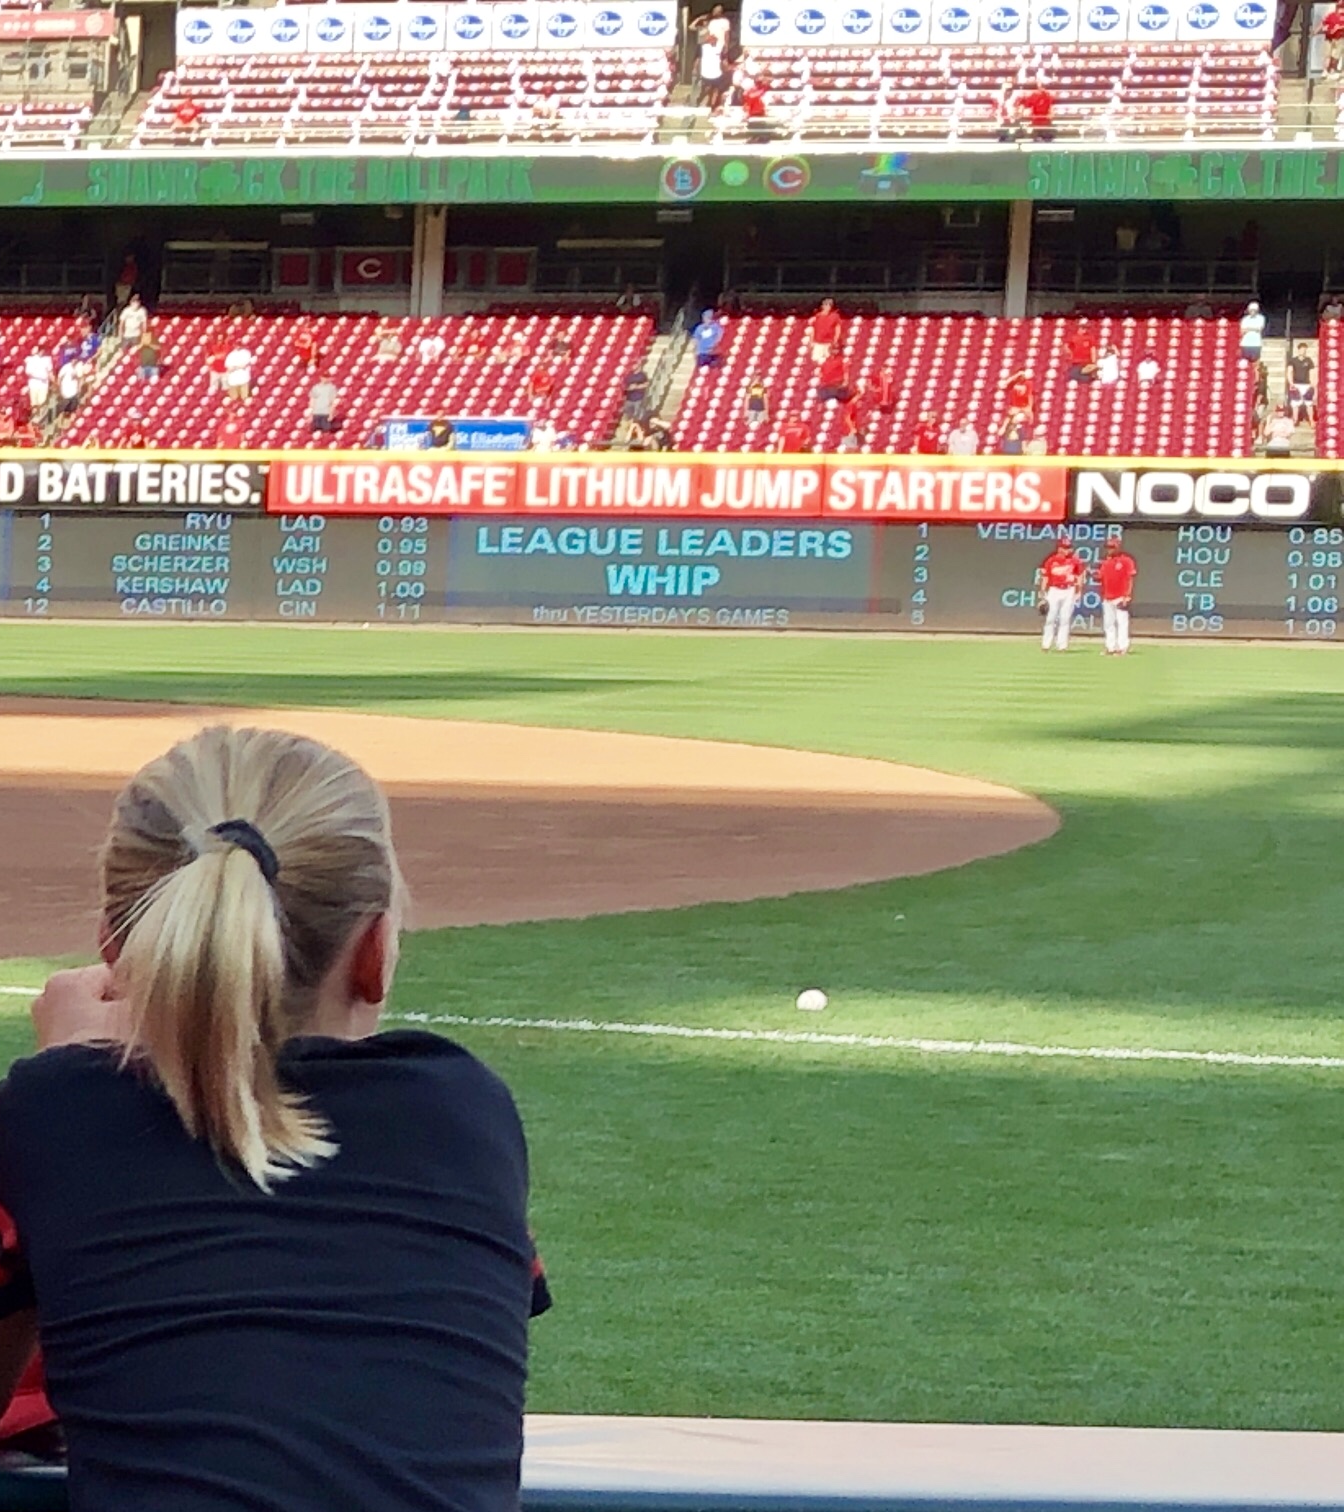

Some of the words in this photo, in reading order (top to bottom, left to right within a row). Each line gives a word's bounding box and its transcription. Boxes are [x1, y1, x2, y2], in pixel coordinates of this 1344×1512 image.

[297, 158, 357, 201] THE
[525, 466, 691, 509] LITHIUM
[699, 468, 819, 510] JUMP
[827, 469, 1052, 514] STARTERS.
[1074, 471, 1313, 517] NOCO
[40, 513, 51, 529] 1
[184, 512, 232, 530] RYU
[279, 514, 326, 532] LAD
[377, 516, 430, 533] 0.93
[917, 522, 928, 539] 1
[976, 522, 1124, 542] VERLANDER
[1176, 525, 1233, 543] HOU
[37, 534, 53, 551] 2
[134, 534, 232, 552] GREINKE
[281, 536, 321, 553] ARI
[476, 526, 644, 557] LEAGUE
[657, 528, 853, 560] LEADERS
[37, 556, 52, 573] 3
[111, 555, 230, 573] SCHERZER
[272, 557, 328, 575] WSH
[915, 544, 930, 561] 2
[1176, 548, 1231, 565] HOU
[1287, 551, 1344, 568] 0.98
[35, 577, 52, 593] 4
[115, 577, 231, 595] KERSHAW
[276, 579, 323, 596] LAD
[376, 581, 426, 599] 1.00
[605, 563, 721, 596] WHIP
[913, 566, 928, 584] 3
[1177, 570, 1225, 588] CLE
[1287, 573, 1338, 590] 1.01
[23, 598, 50, 616] 12
[119, 598, 228, 616] CASTILLO
[278, 600, 317, 618] CIN
[376, 603, 423, 620] 1.11
[911, 588, 928, 605] 4
[1184, 592, 1216, 611] TB
[1285, 595, 1339, 613] 1.06
[532, 604, 568, 622] thru
[573, 605, 711, 625] YESTERDAY'S
[716, 607, 790, 626] GAMES
[1172, 614, 1225, 633] BOS
[1285, 618, 1338, 636] 1.09
